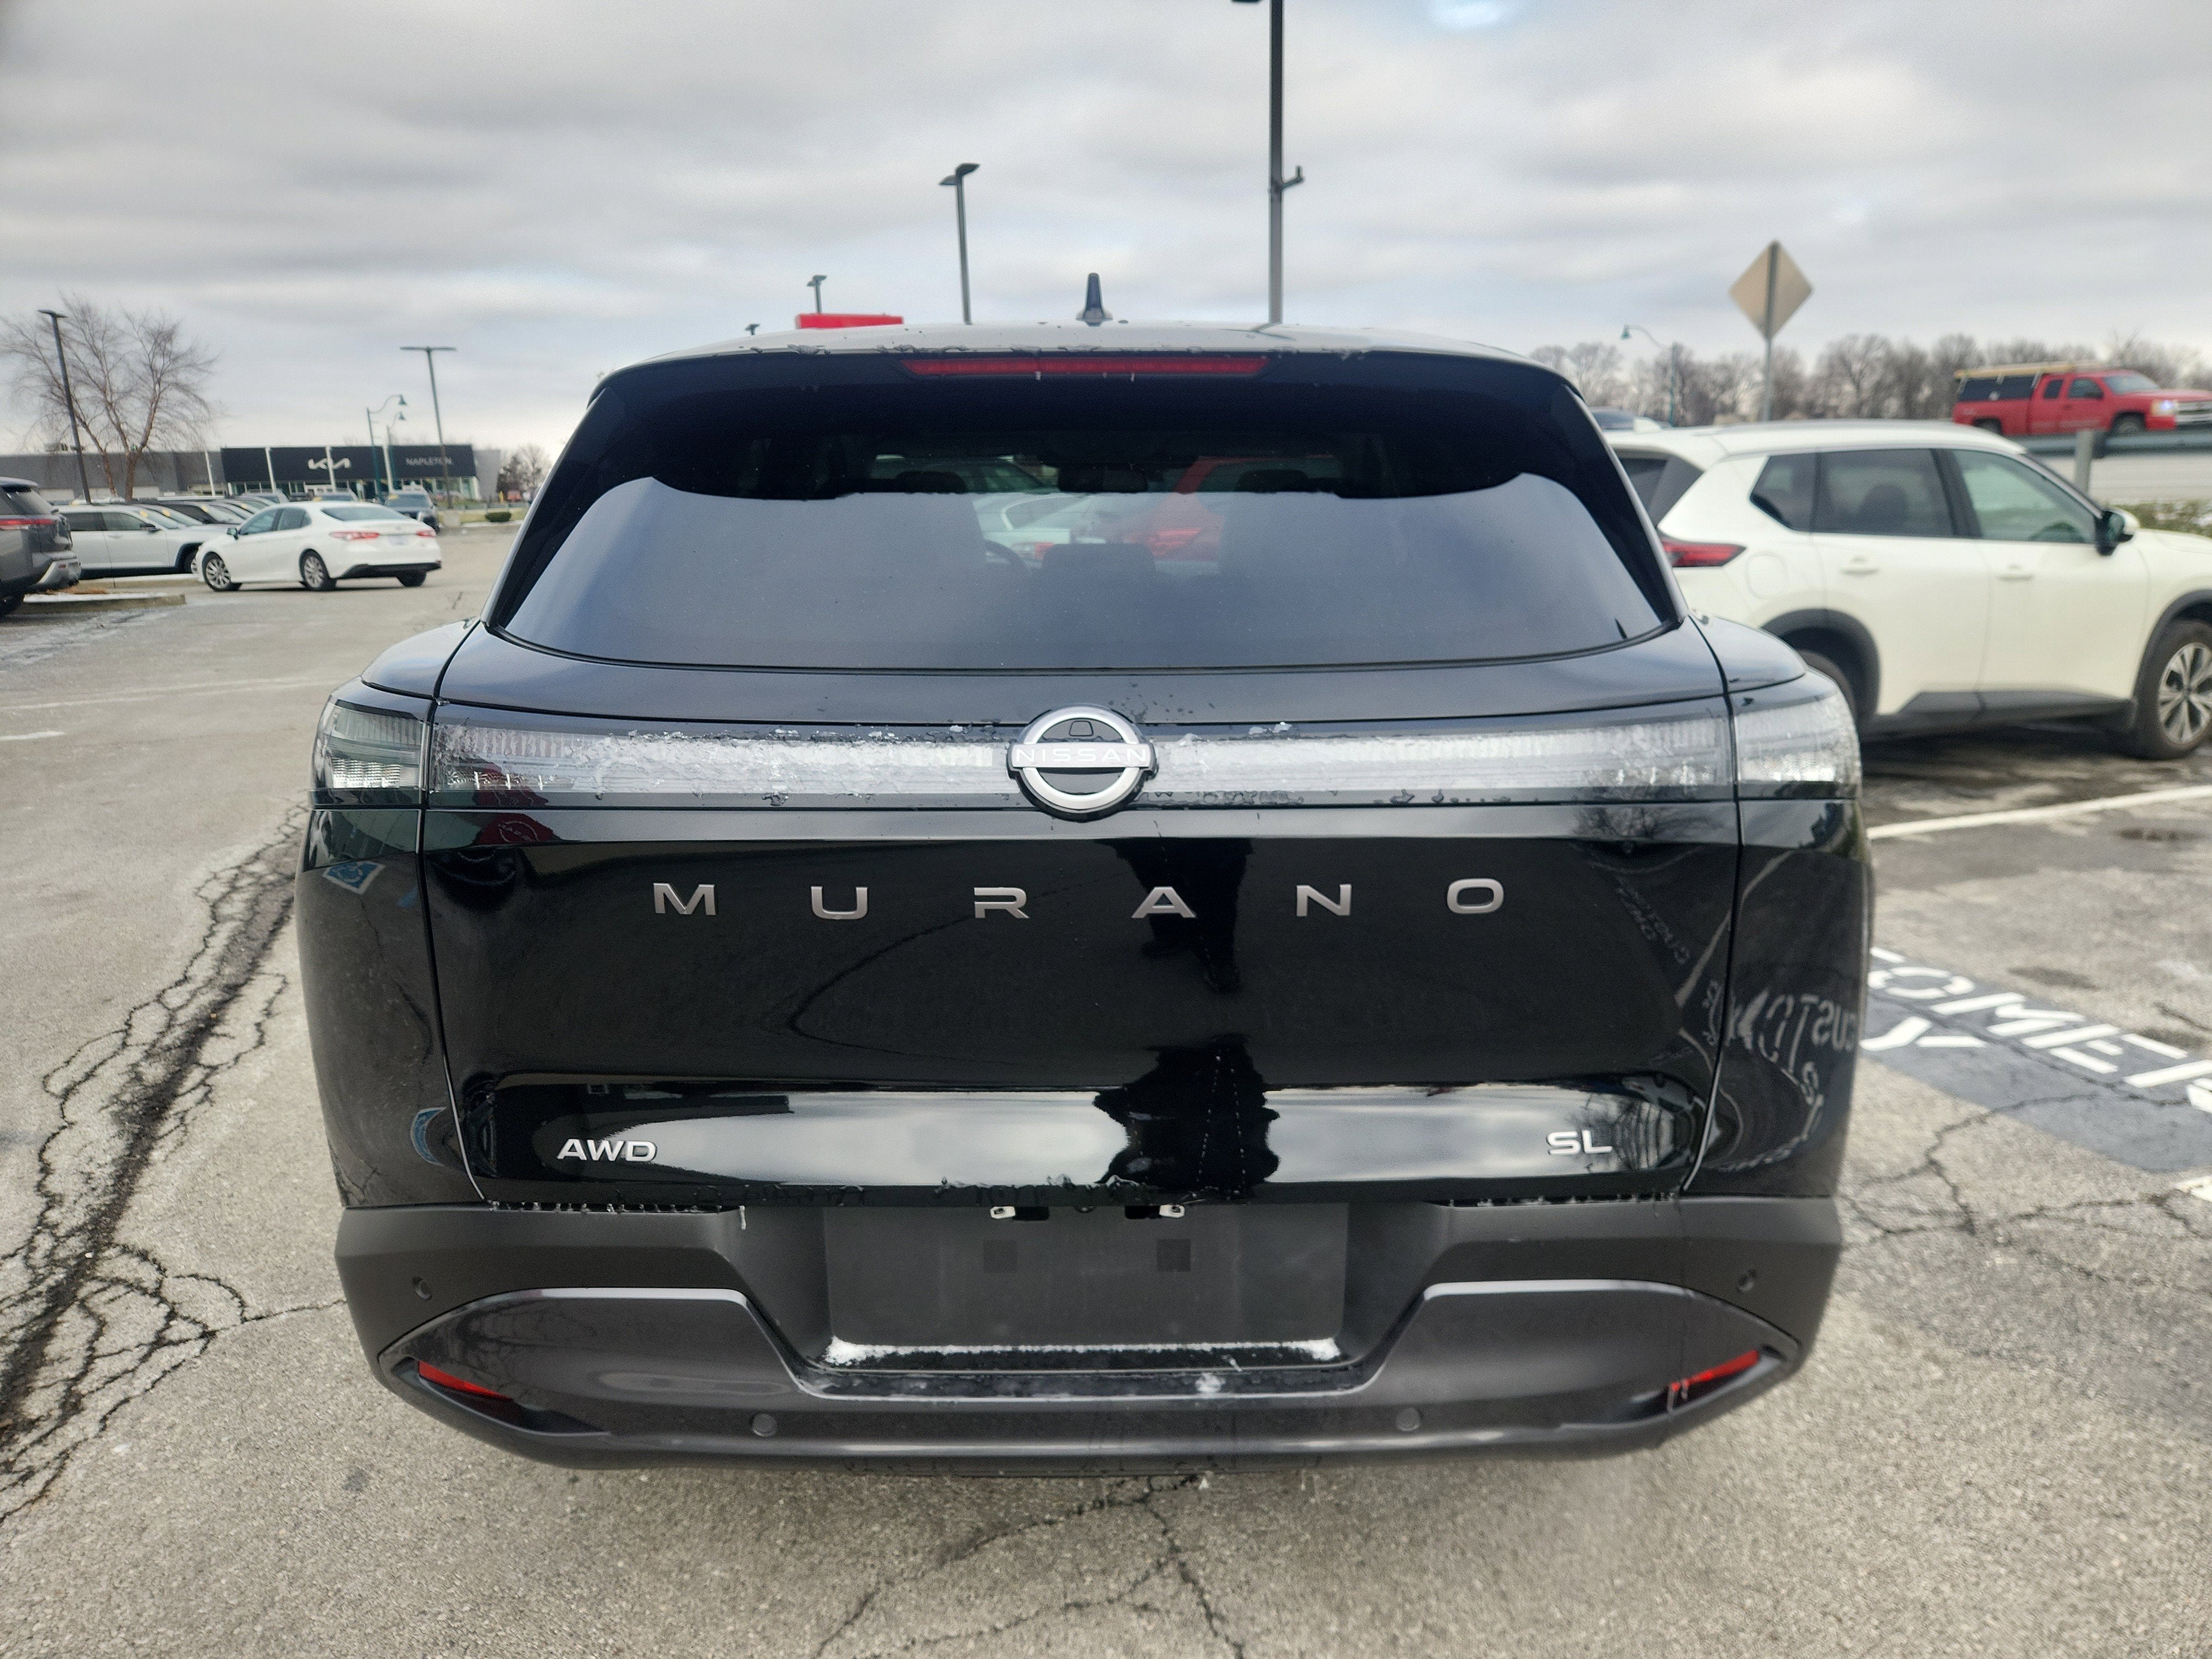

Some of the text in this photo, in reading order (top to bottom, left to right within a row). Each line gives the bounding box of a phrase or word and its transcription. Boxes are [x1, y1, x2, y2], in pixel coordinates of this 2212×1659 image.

[1015, 747, 1147, 762] NISSAN
[653, 878, 1504, 920] MURANO
[557, 1139, 657, 1162] AWD
[1547, 1130, 1613, 1154] SL
